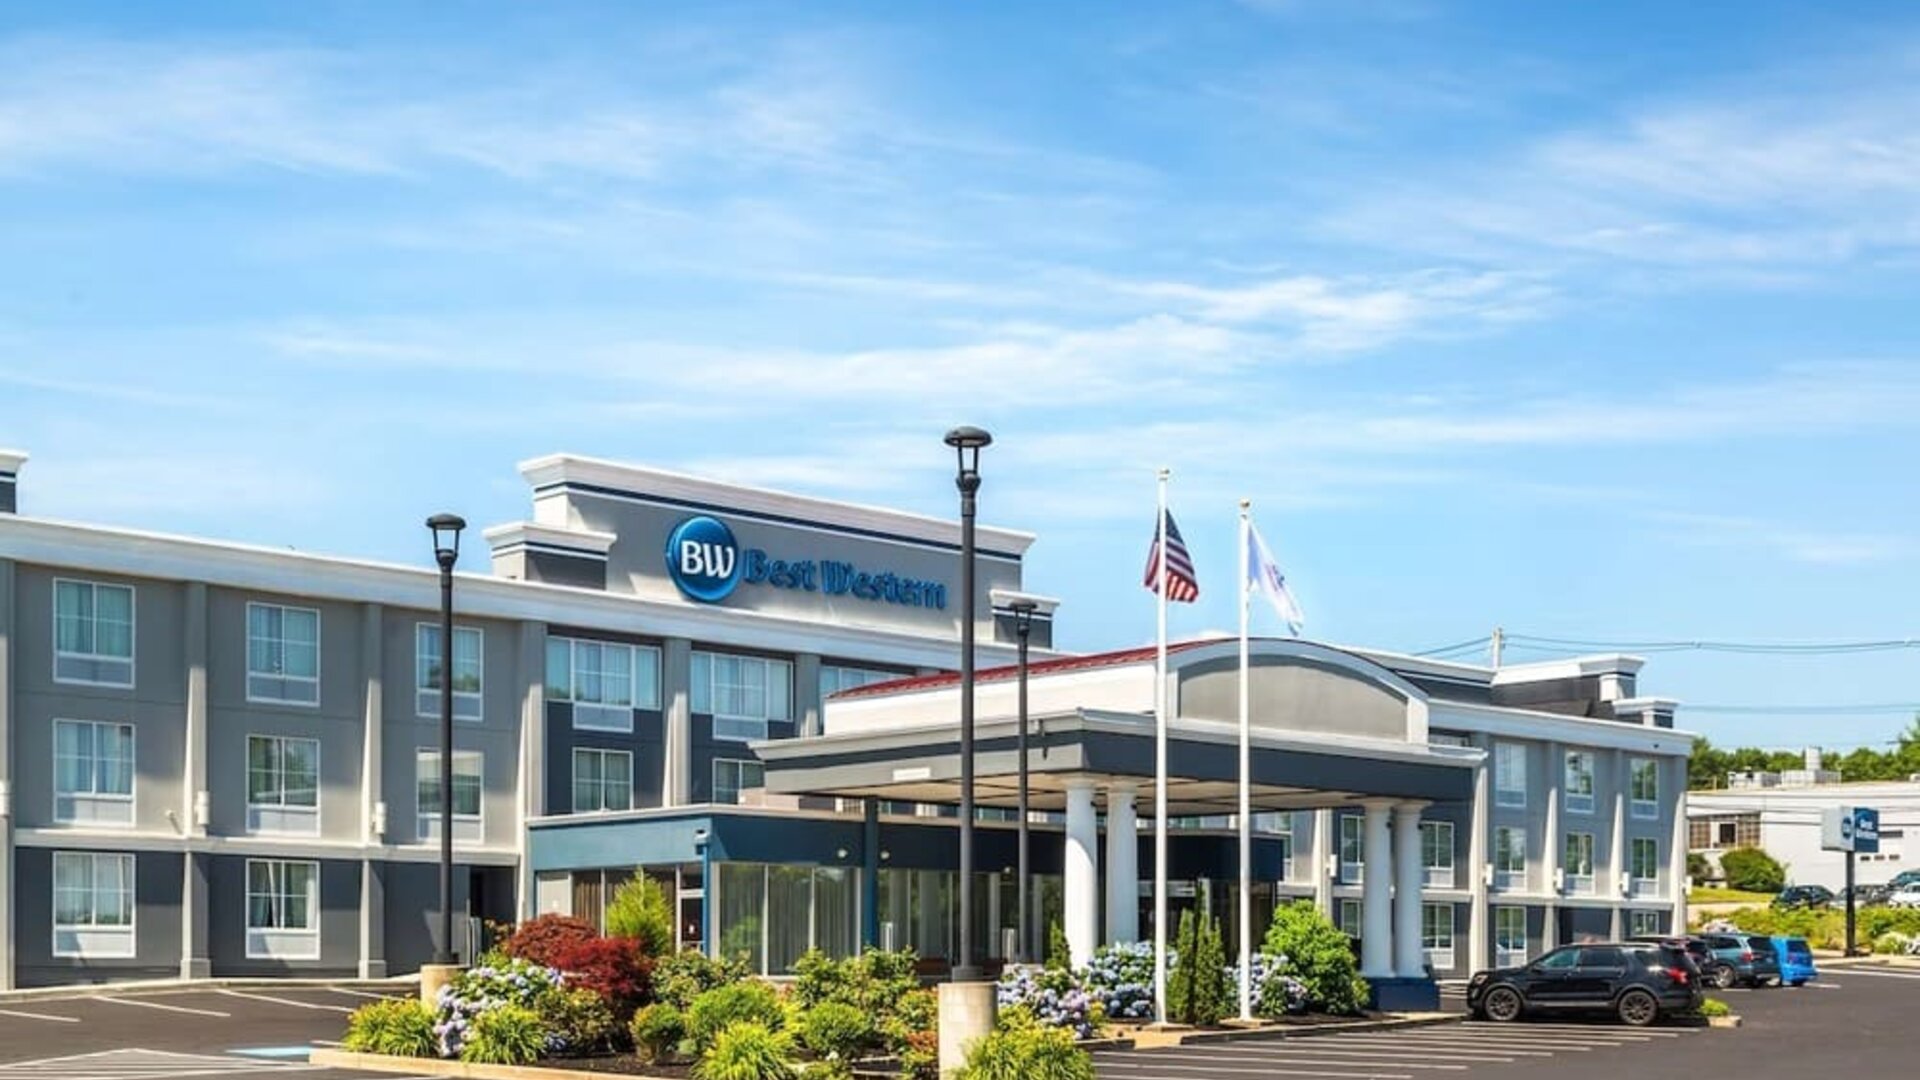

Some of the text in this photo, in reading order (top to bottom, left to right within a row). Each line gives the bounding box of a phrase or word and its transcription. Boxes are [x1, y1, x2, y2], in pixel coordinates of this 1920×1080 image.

[681, 541, 735, 578] BW
[743, 548, 946, 611] Best Western
